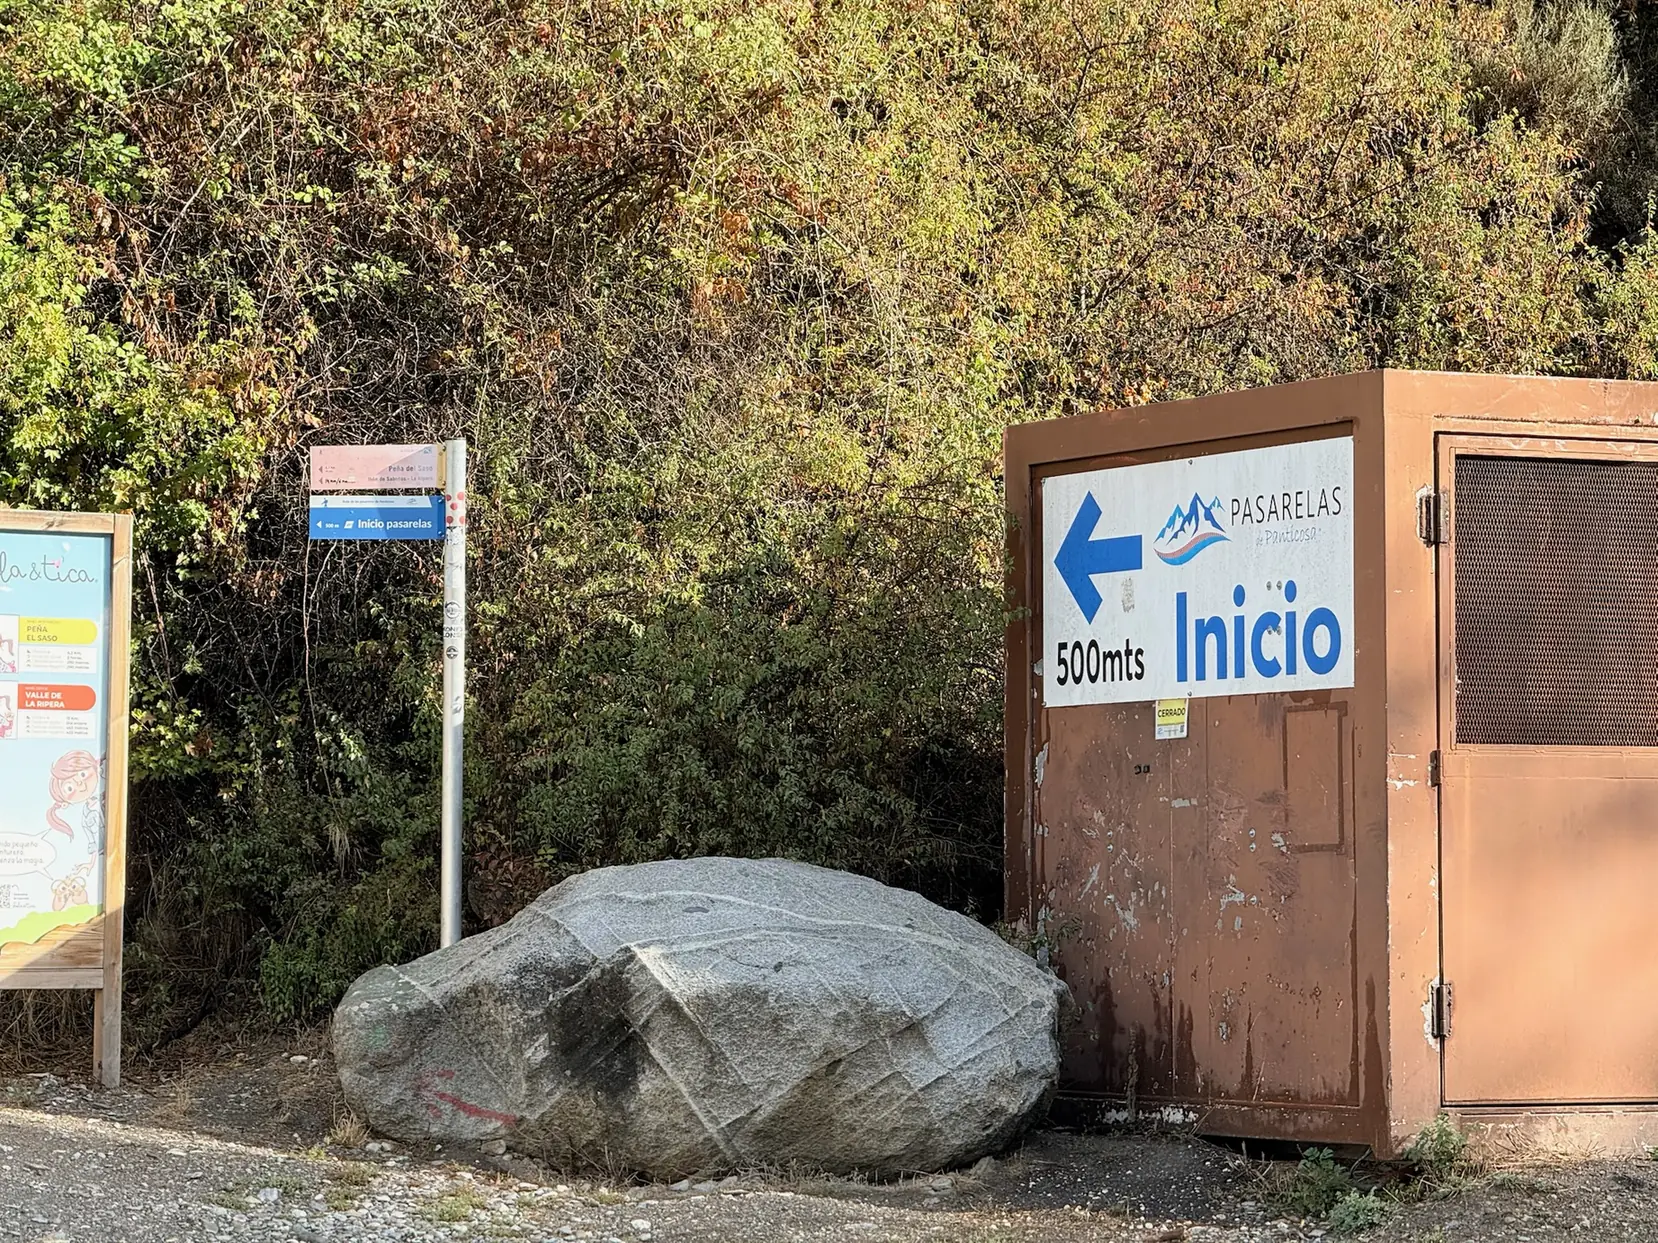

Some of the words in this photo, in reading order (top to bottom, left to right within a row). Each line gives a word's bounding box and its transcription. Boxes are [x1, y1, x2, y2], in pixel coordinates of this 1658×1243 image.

[388, 464, 404, 472] Peña
[1231, 486, 1342, 526] PASARELAS
[358, 519, 384, 529] Inicio
[386, 519, 432, 530] pasarelas
[1265, 525, 1316, 545] Panticosa
[26, 625, 48, 633] PEÑA
[1176, 580, 1341, 683] Inicio
[26, 634, 36, 642] EL
[37, 634, 58, 642] SASO
[1056, 638, 1145, 686] 500mts
[25, 691, 49, 699] VALLE
[25, 700, 35, 708] LA
[37, 700, 65, 708] RIPERA
[1157, 707, 1186, 718] CERRADO
